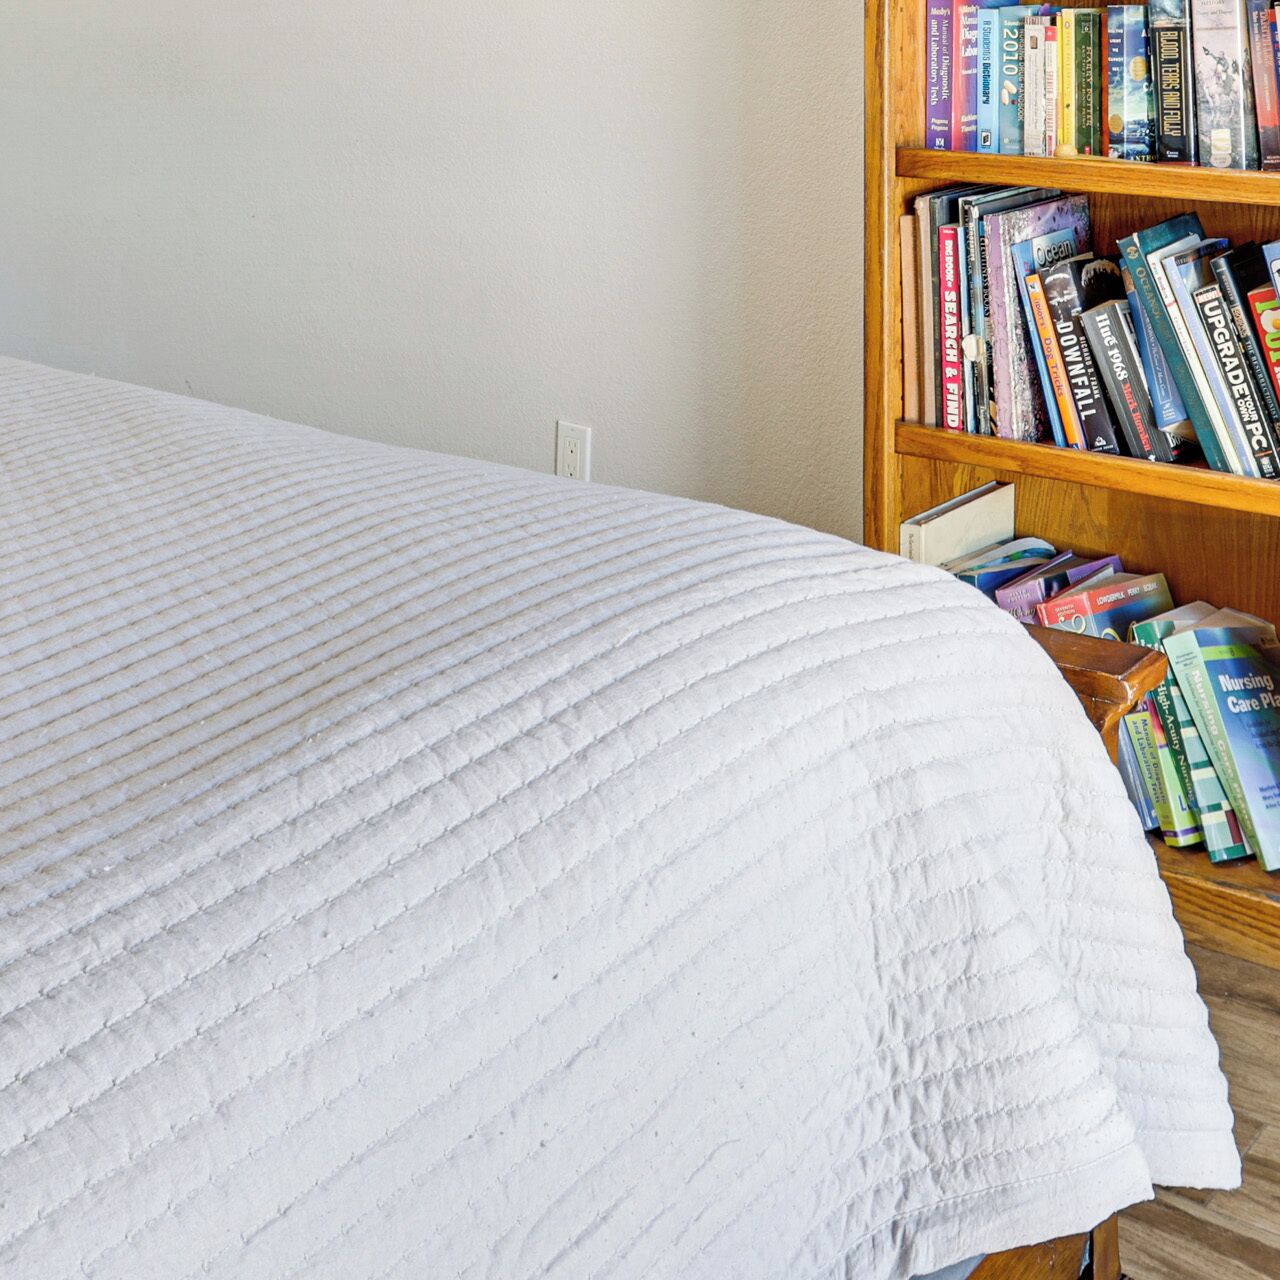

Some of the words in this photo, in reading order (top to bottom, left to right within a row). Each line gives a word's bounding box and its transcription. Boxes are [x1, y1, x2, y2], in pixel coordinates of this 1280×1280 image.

[942, 46, 949, 54] of
[1003, 28, 1018, 75] 2010
[1160, 31, 1179, 60] BLOOD,
[930, 37, 939, 84] Laboratory
[941, 56, 950, 99] Diagnostic
[1162, 63, 1180, 89] TEARS
[931, 86, 939, 105] Tests
[1164, 92, 1180, 108] AND
[1164, 110, 1182, 136] FOLLY
[944, 291, 956, 362] SEARCH
[1107, 348, 1128, 380] 1968
[1204, 306, 1249, 398] UPGRADE
[947, 367, 958, 378] &
[1056, 321, 1097, 420] DOWNFALL
[947, 383, 960, 427] FIND
[1236, 399, 1248, 421] OWN
[1242, 396, 1258, 421] YOUR
[1249, 424, 1270, 450] PC
[1219, 673, 1274, 692] Nursing
[1228, 695, 1260, 713] Care
